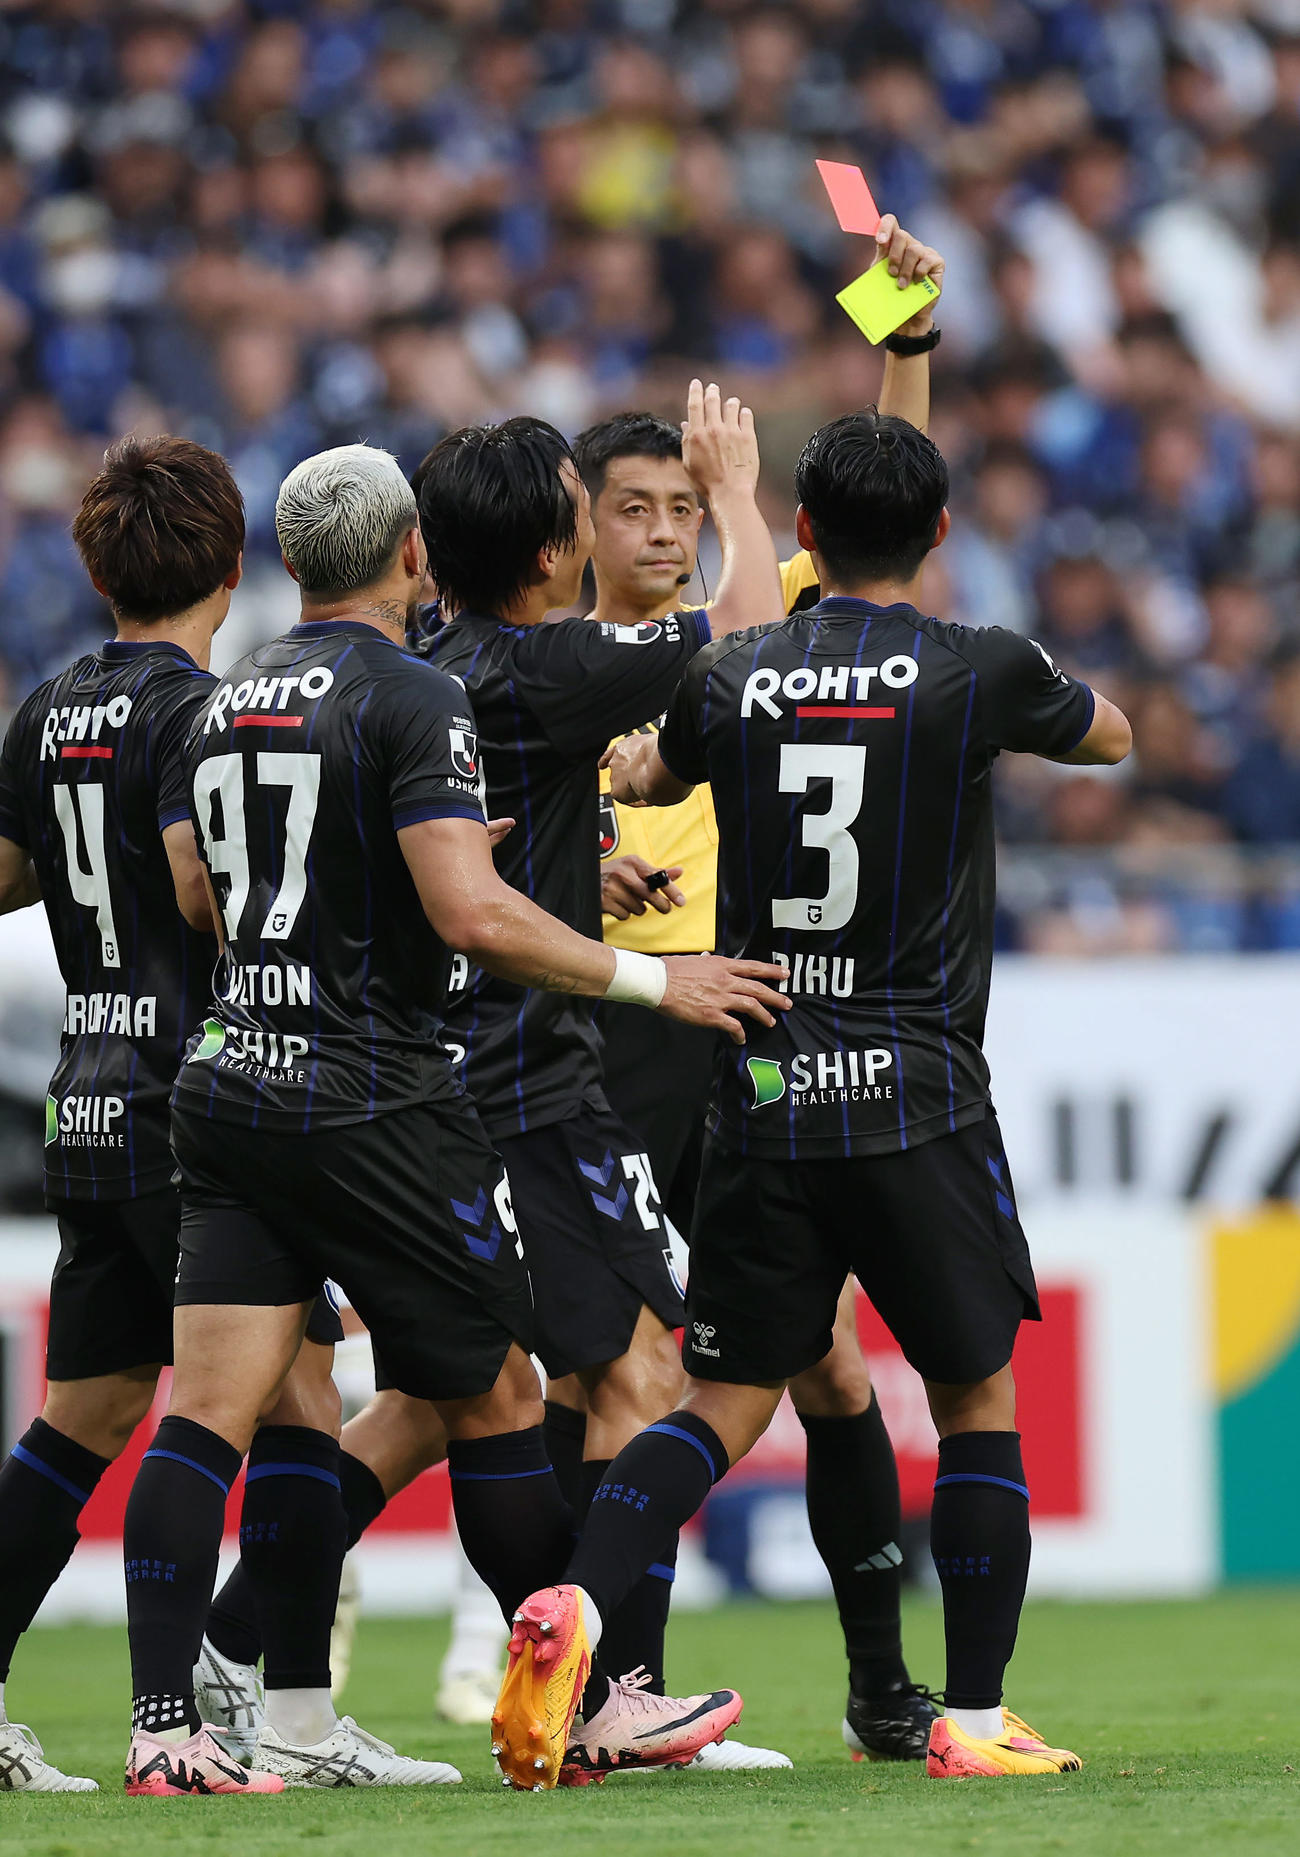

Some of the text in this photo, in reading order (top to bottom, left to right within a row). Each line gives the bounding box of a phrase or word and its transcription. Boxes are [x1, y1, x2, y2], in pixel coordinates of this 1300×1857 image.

[203, 666, 334, 734] ROHTO
[741, 654, 919, 720] ROHTO
[193, 752, 322, 942] 97
[771, 743, 867, 931] 3
[53, 783, 121, 969] 4
[218, 1055, 305, 1083] HEALTHCARE
[225, 1026, 309, 1069] SHIP
[789, 1048, 893, 1092] SHIP
[59, 1096, 125, 1133] SHIP
[792, 1086, 893, 1106] HEALTHCARE
[61, 1133, 125, 1148] HEALTHCARE
[691, 1341, 721, 1358] hummel
